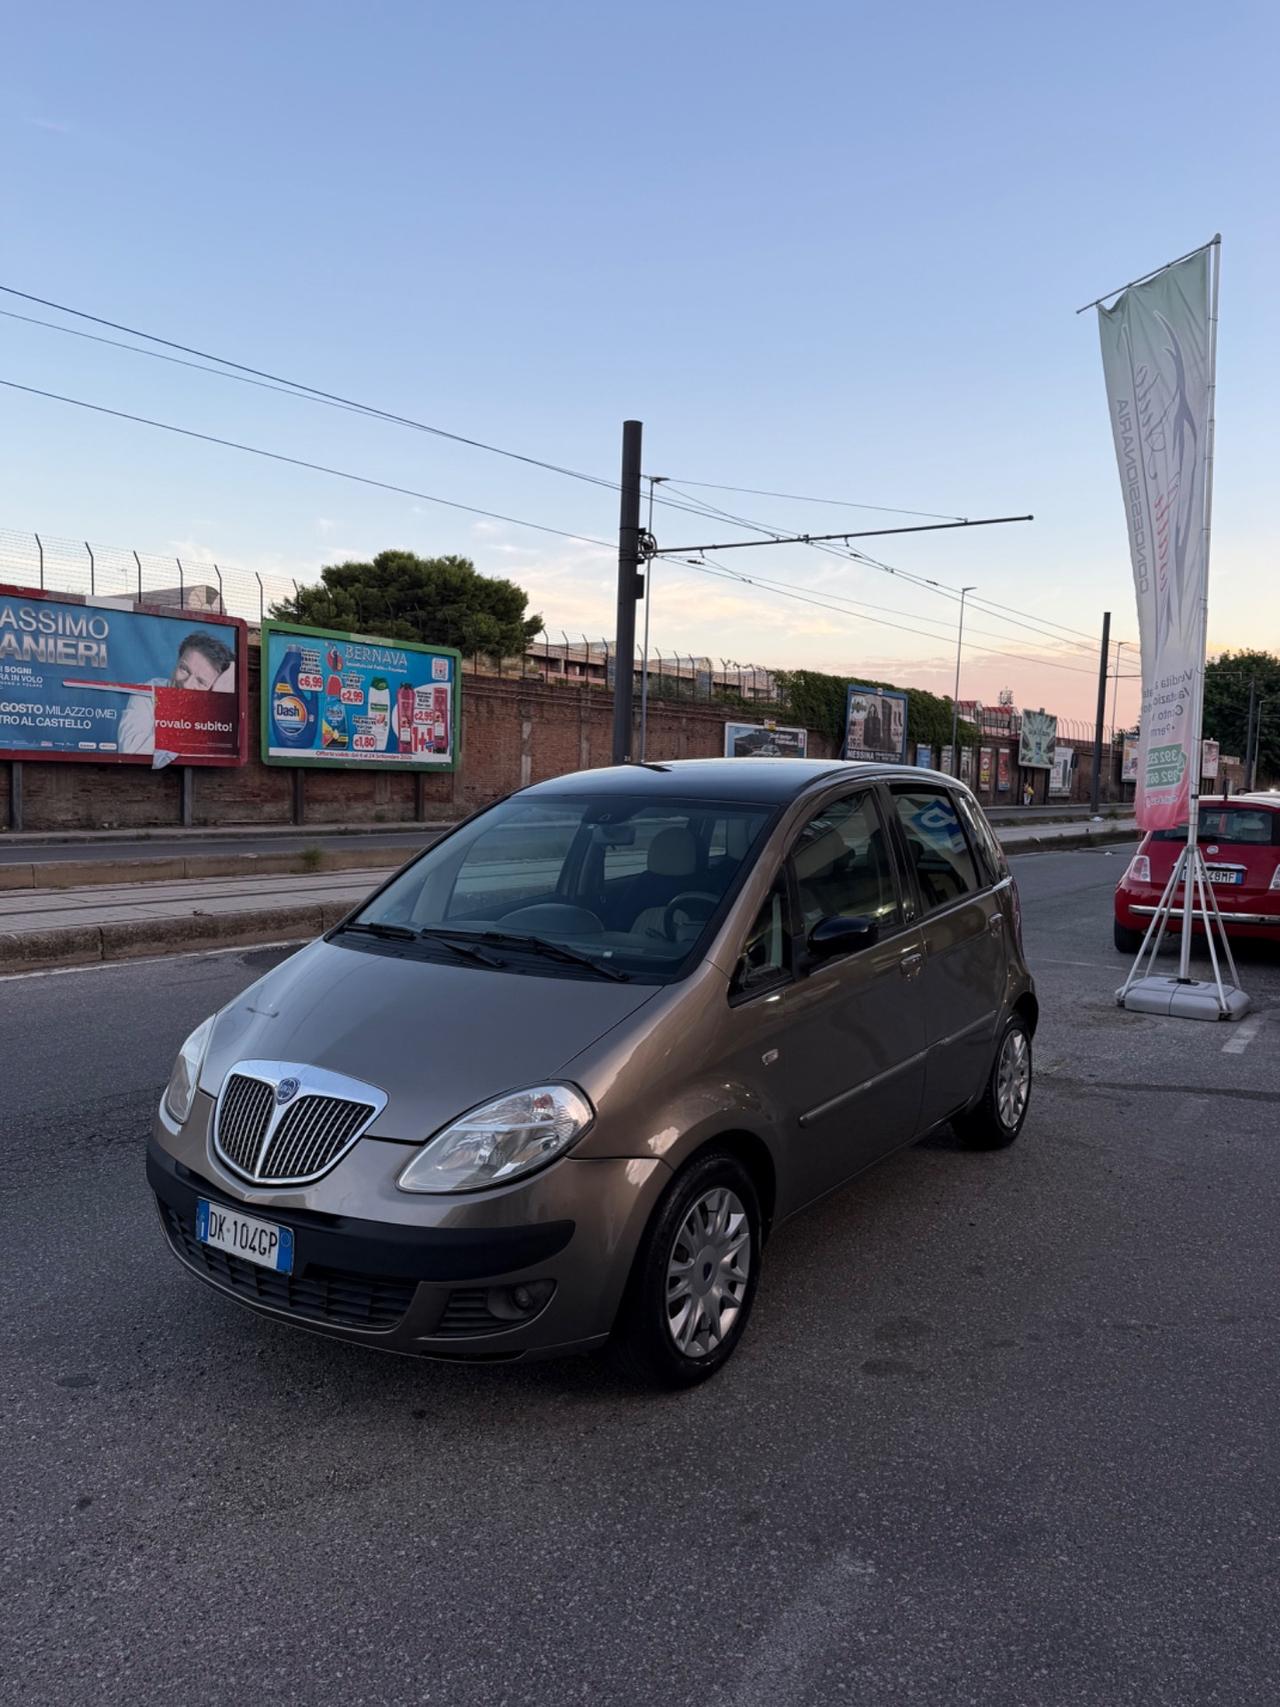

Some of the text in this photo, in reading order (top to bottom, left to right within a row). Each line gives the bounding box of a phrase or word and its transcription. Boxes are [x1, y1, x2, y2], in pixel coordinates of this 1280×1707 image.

[345, 644, 408, 666] BERNAVA
[4, 666, 32, 675] SOGNI
[21, 676, 44, 684] VOLO
[45, 705, 95, 718] MILAZZO
[276, 703, 300, 717] Dash
[20, 717, 35, 726] AL
[36, 718, 92, 729] CASTELLO
[194, 721, 233, 732] subito!
[209, 1211, 278, 1256] DK 104GP
